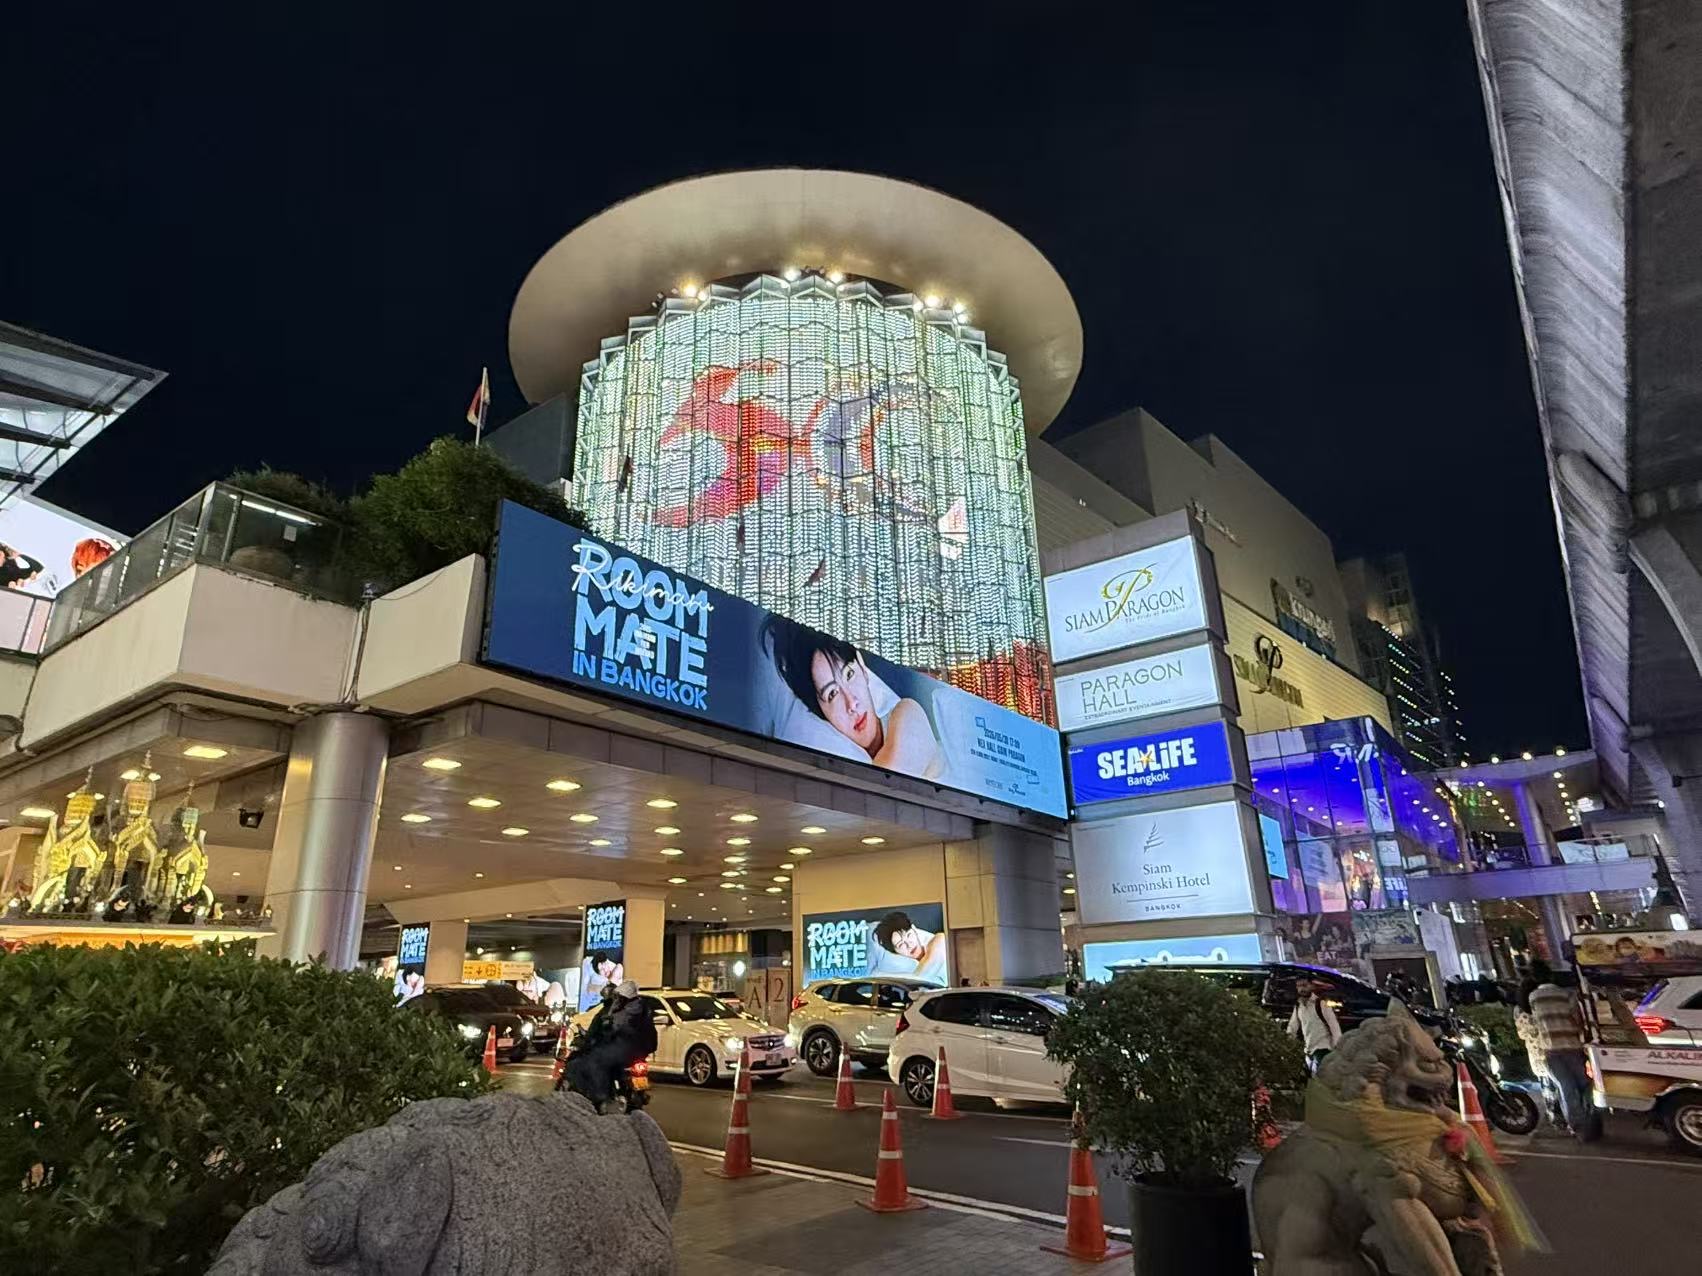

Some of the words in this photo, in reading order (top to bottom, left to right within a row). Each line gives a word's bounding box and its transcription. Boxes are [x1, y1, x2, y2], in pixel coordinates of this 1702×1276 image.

[577, 538, 708, 638] ROOM
[1065, 608, 1105, 632] SIAM
[574, 594, 708, 687] MATE
[572, 651, 596, 678] IN
[600, 659, 708, 710] BANGKOK
[1081, 660, 1183, 697] PARAGON
[1083, 689, 1137, 713] HALL
[1097, 746, 1144, 779] SEA
[1127, 771, 1170, 786] Bangkok
[1143, 863, 1172, 876] Siam
[1111, 877, 1173, 895] Kempinski
[1176, 873, 1211, 888] Hotel
[587, 906, 624, 926] ROOM
[1145, 903, 1182, 912] BANGKOK
[587, 924, 622, 943] MATE
[807, 920, 868, 947] ROOM
[811, 944, 868, 970] MATE
[748, 986, 761, 1008] A
[773, 977, 785, 1003] 2
